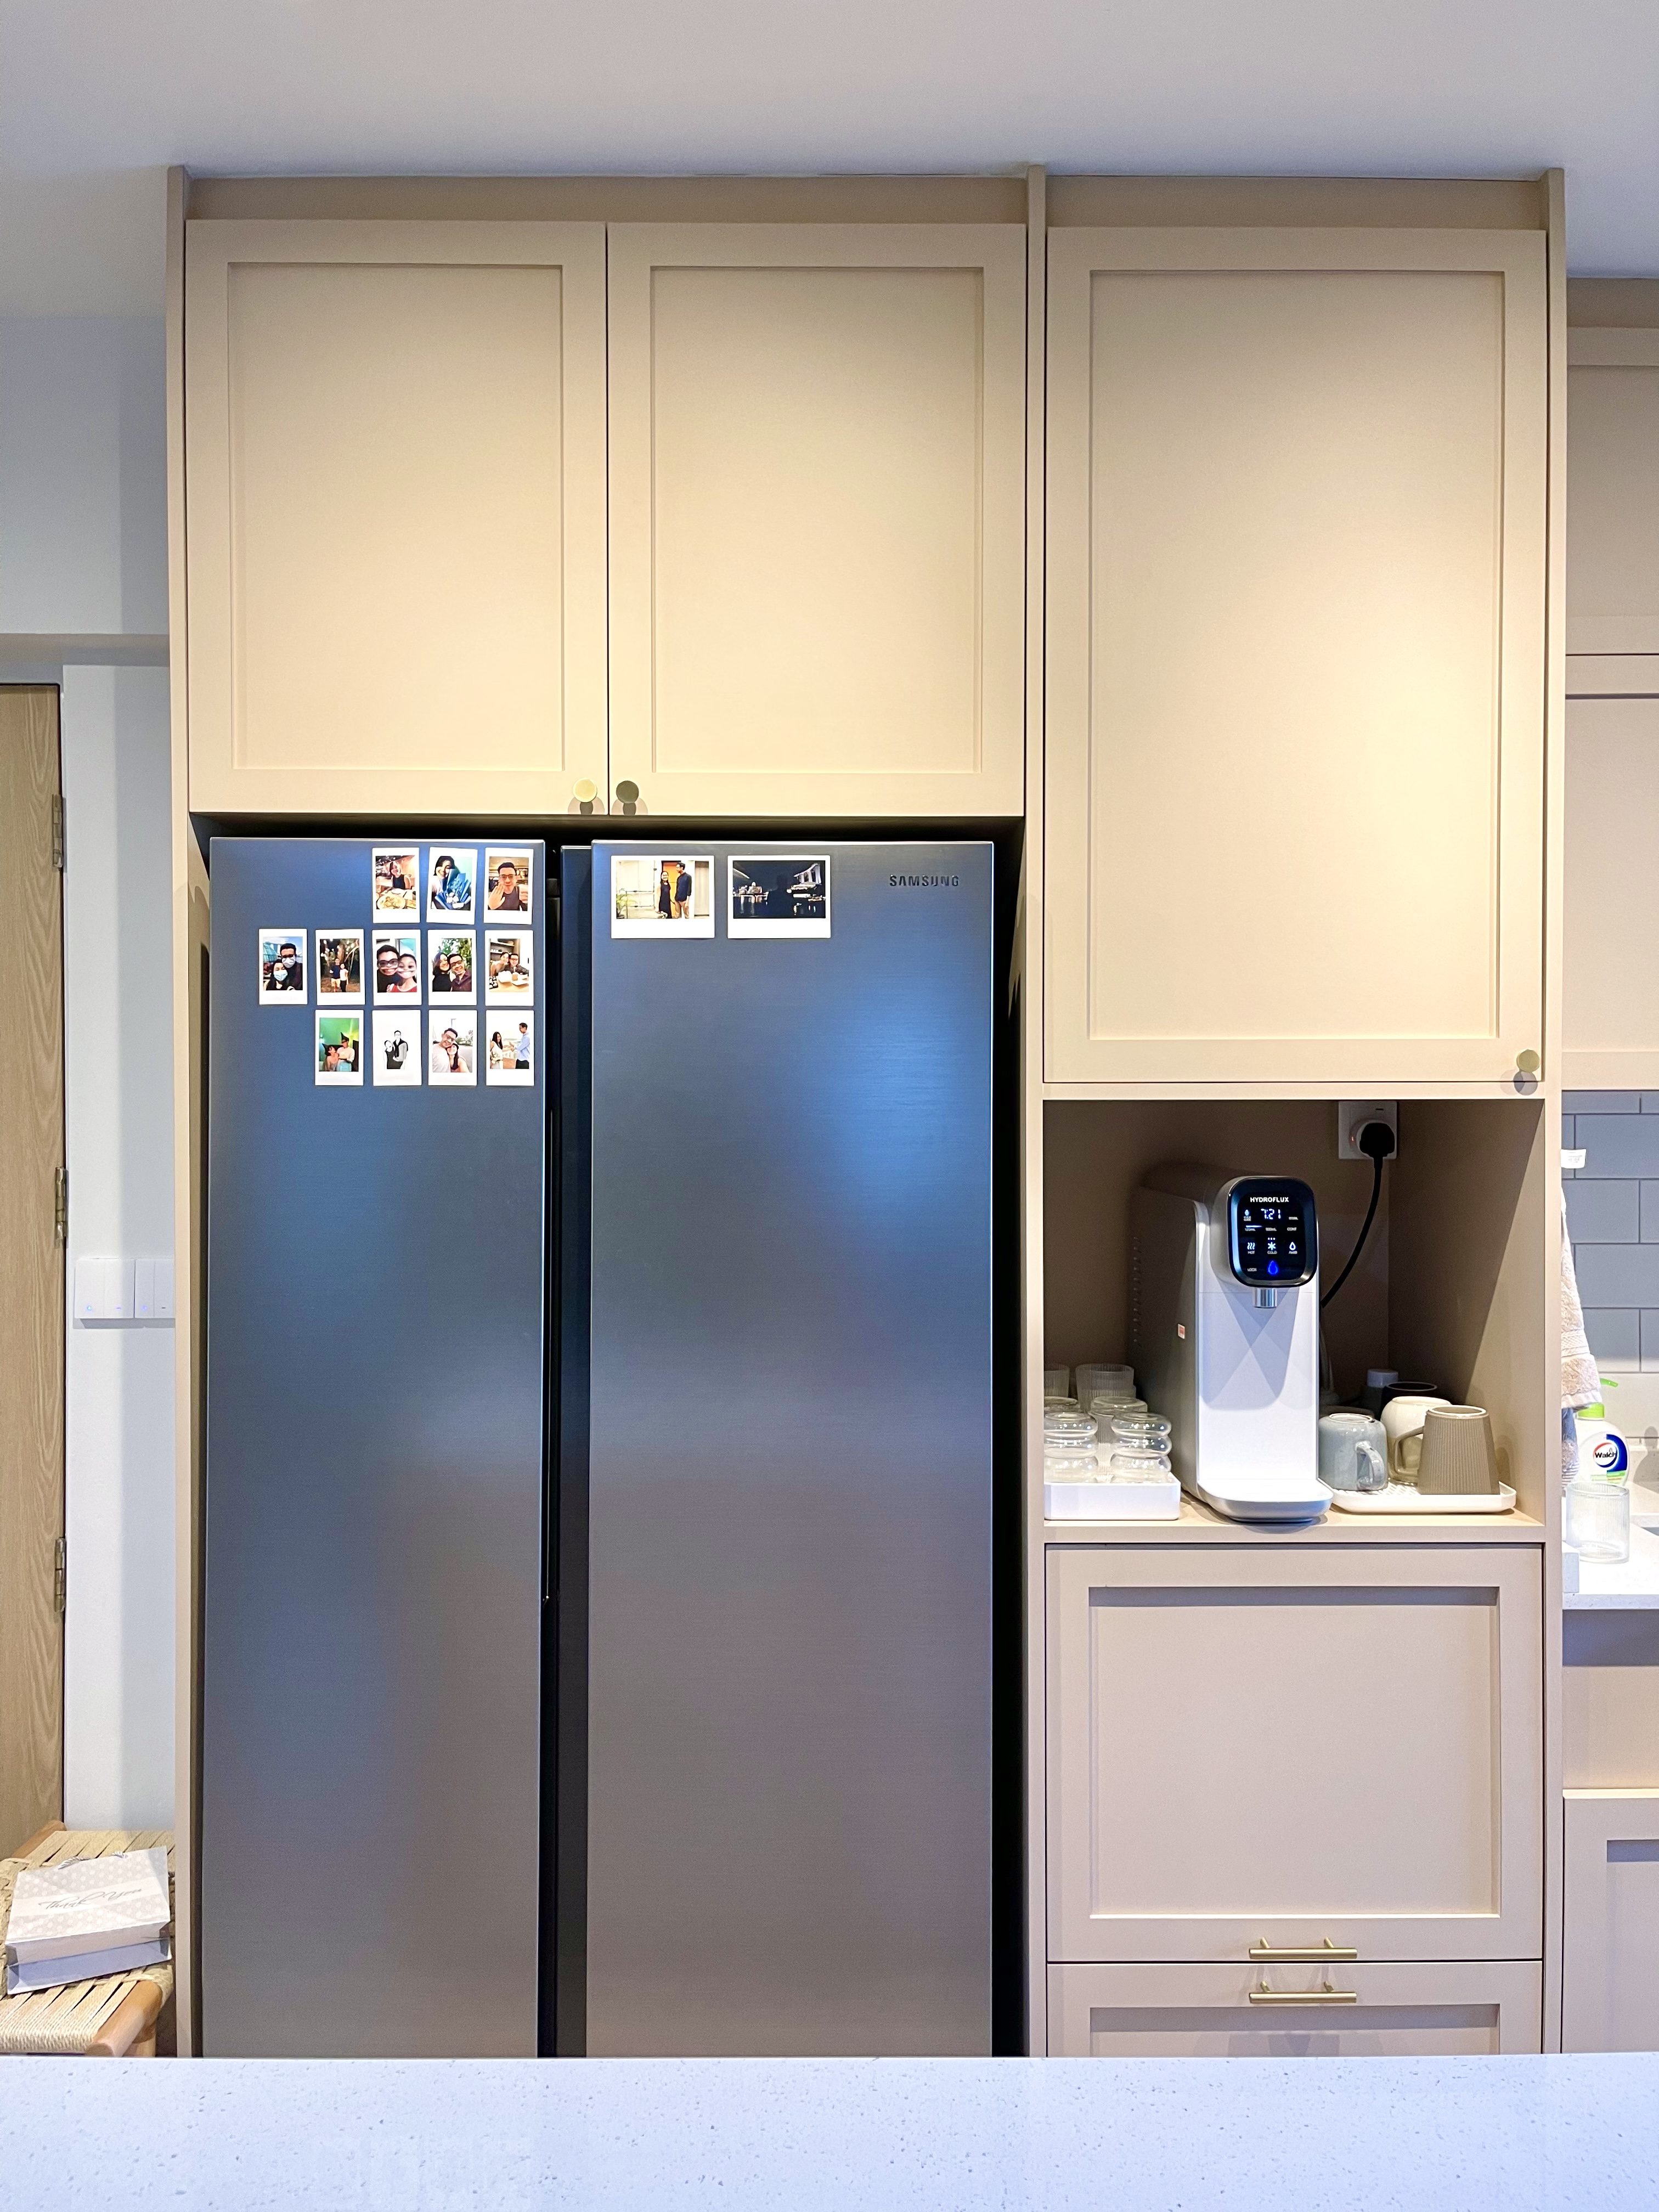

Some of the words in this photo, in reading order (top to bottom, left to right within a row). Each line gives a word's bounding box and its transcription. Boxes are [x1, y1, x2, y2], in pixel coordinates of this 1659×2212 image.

[889, 875, 959, 887] SAMSUNG
[38, 1891, 105, 1910] Thank
[102, 1888, 142, 1901] You
